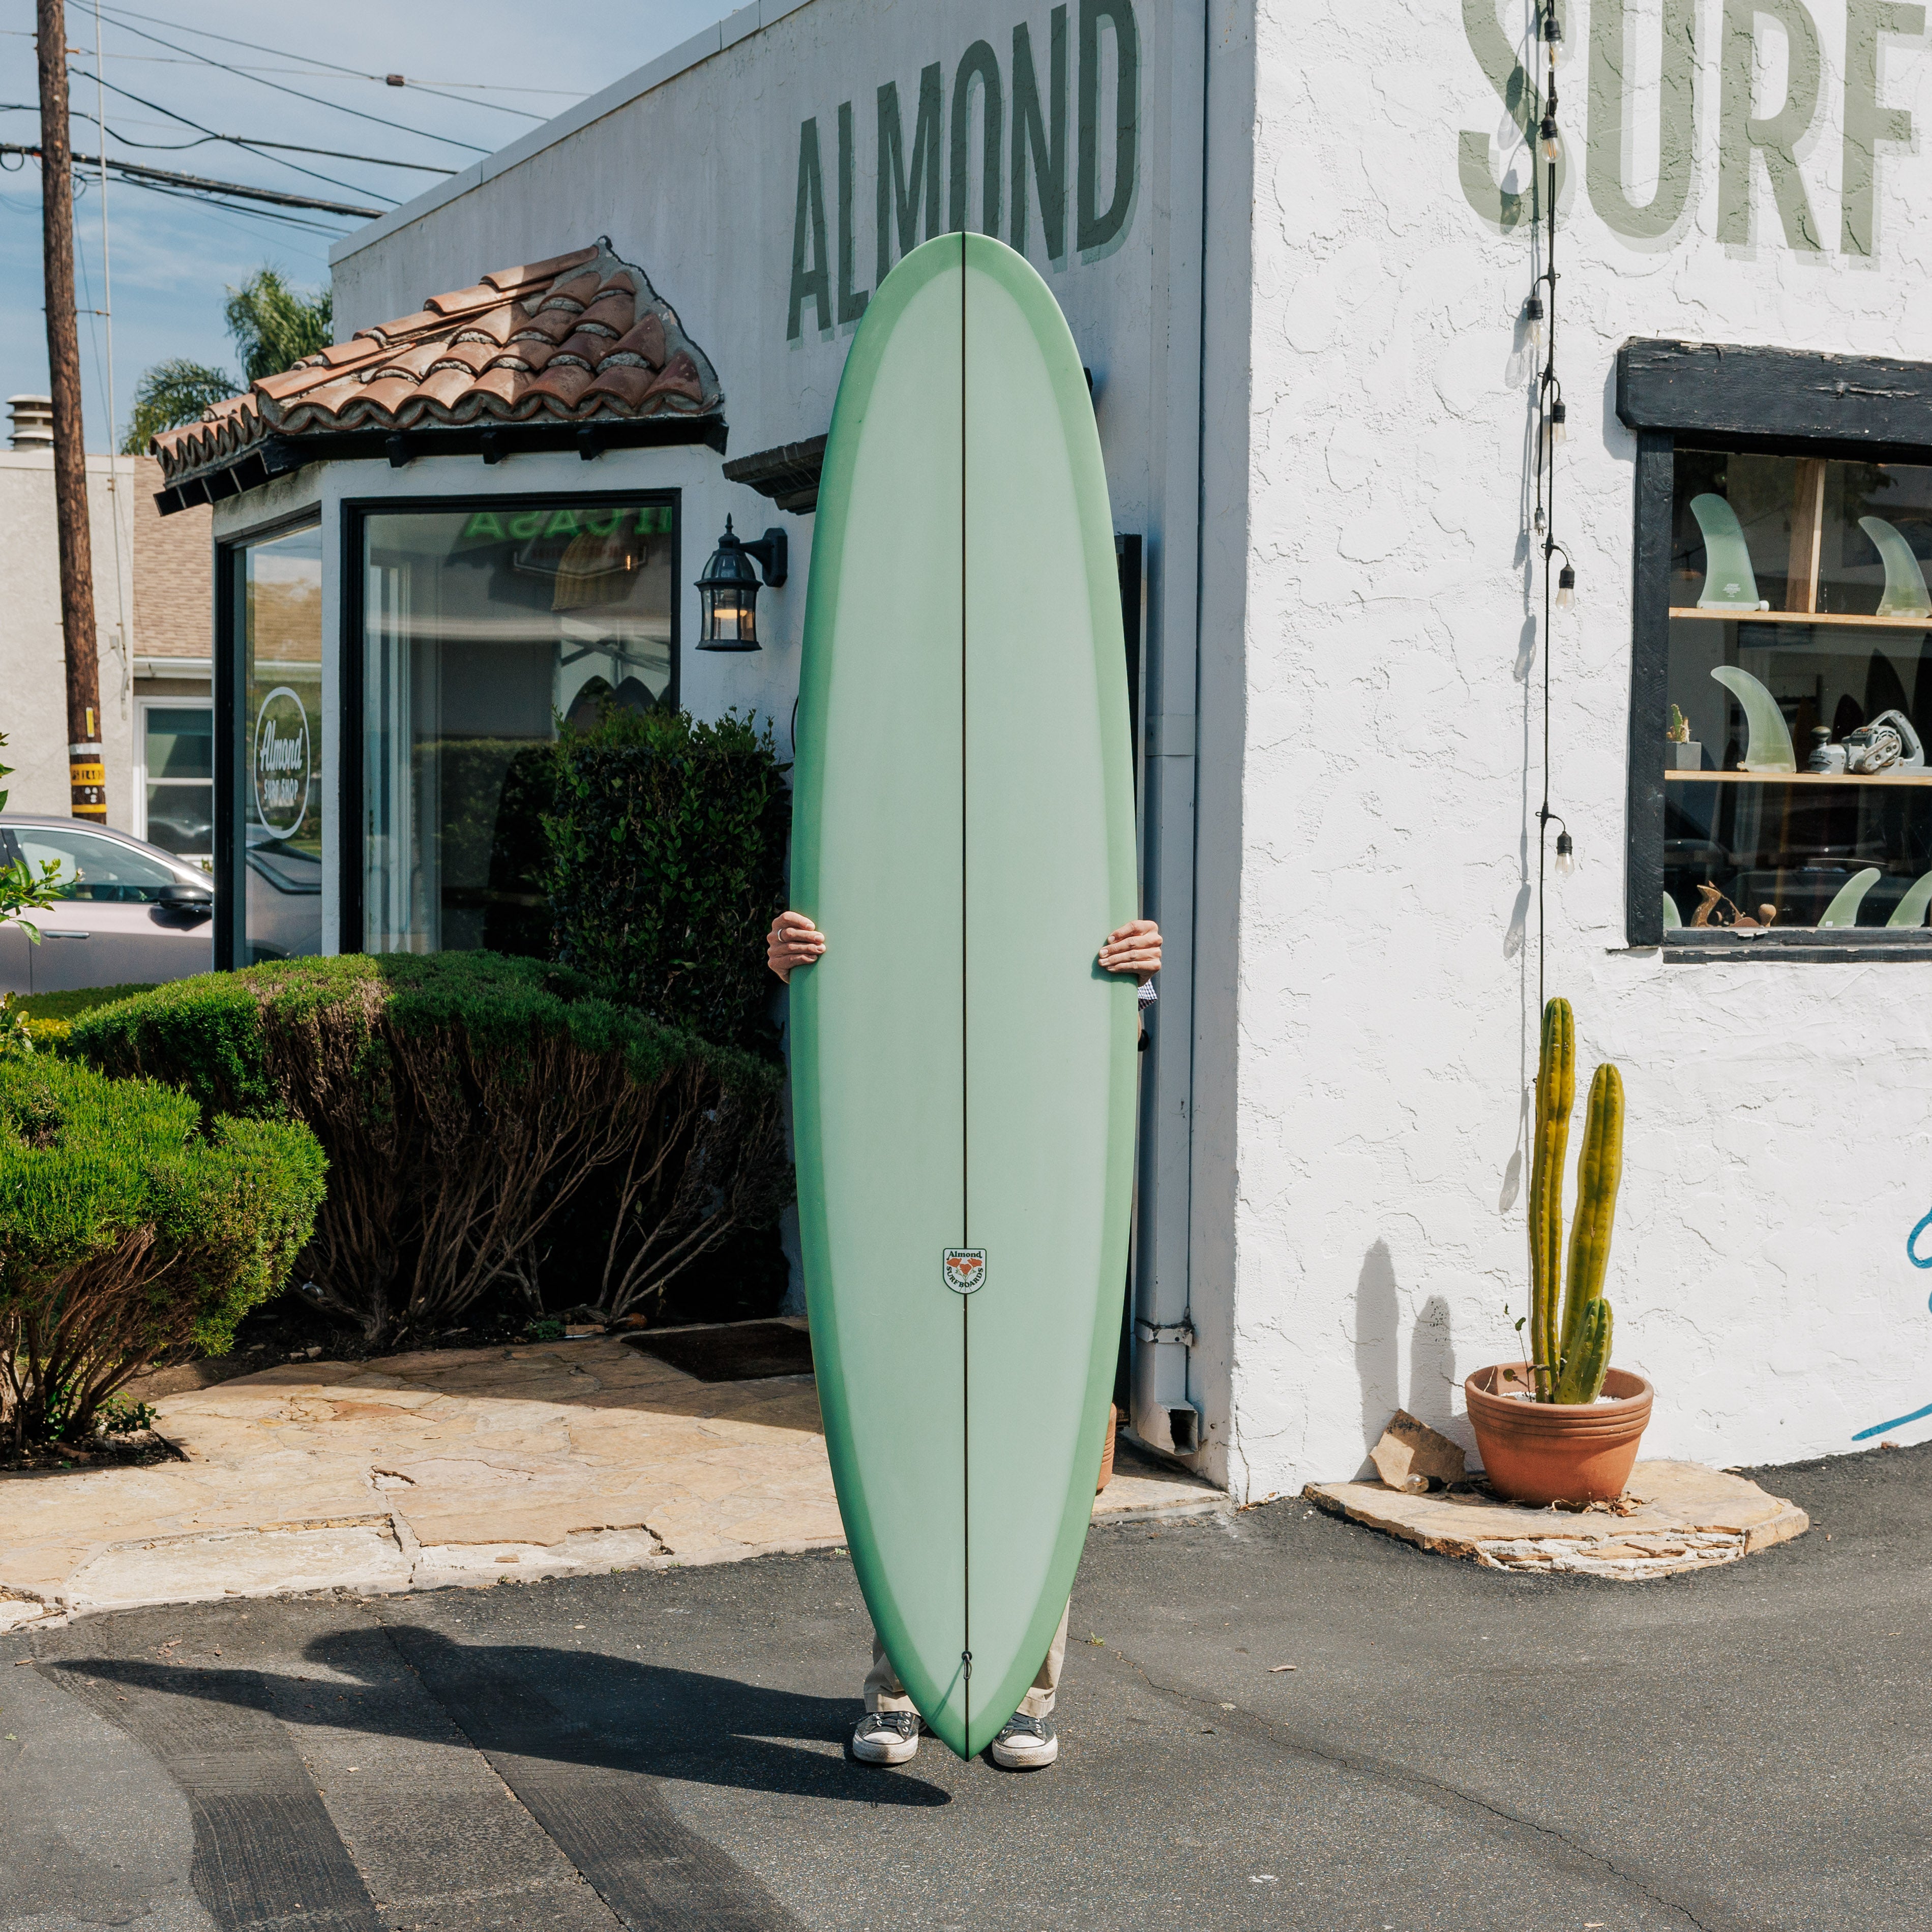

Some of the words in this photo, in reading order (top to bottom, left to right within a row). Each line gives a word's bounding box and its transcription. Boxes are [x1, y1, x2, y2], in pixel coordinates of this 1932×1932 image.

[1458, 0, 1931, 272] SURF
[786, 0, 1141, 351] ALMOND
[260, 720, 303, 771] Almond
[281, 778, 299, 800] SHOP
[946, 1251, 983, 1260] Almond
[946, 1266, 984, 1288] SURFBOARDS
